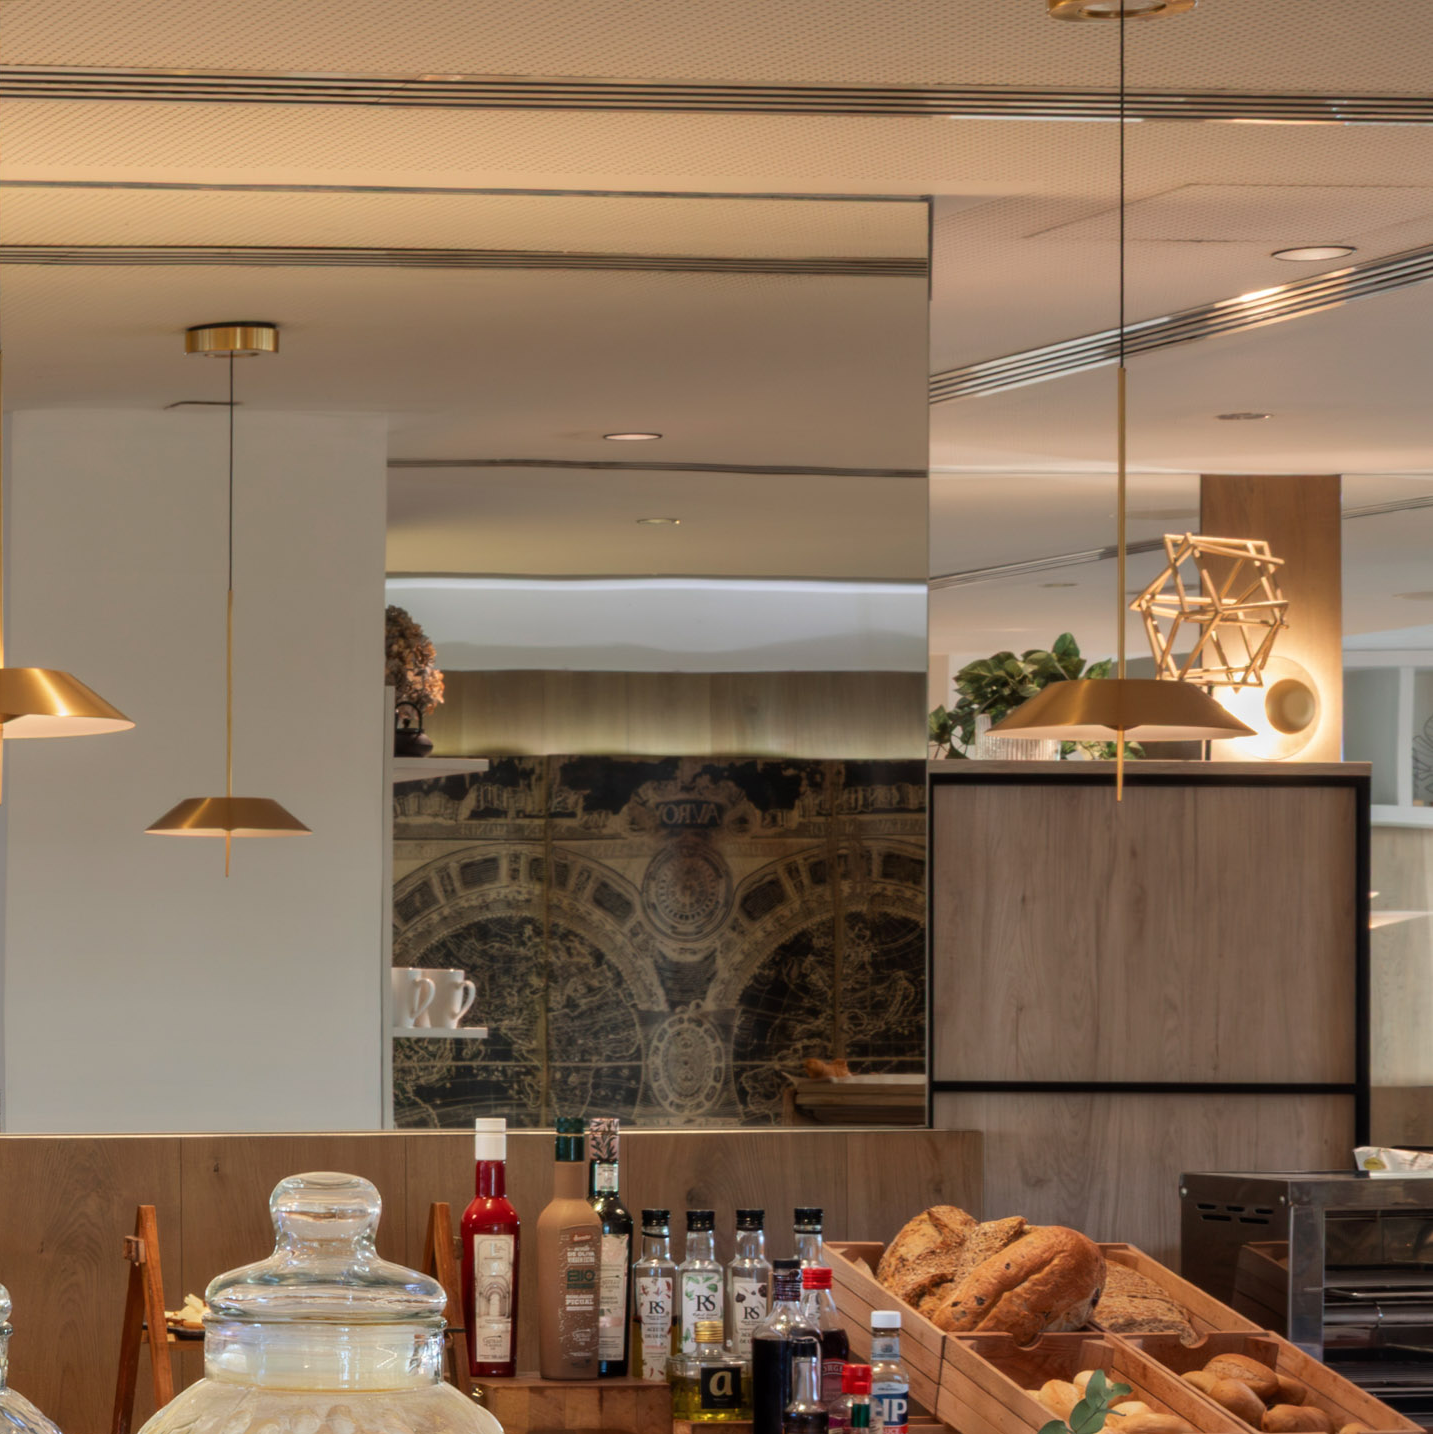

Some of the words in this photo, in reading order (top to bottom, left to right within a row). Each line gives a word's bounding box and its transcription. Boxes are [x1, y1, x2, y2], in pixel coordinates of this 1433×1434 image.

[649, 1300, 666, 1315] RS
[696, 1294, 716, 1312] RS
[744, 1306, 761, 1320] RS
